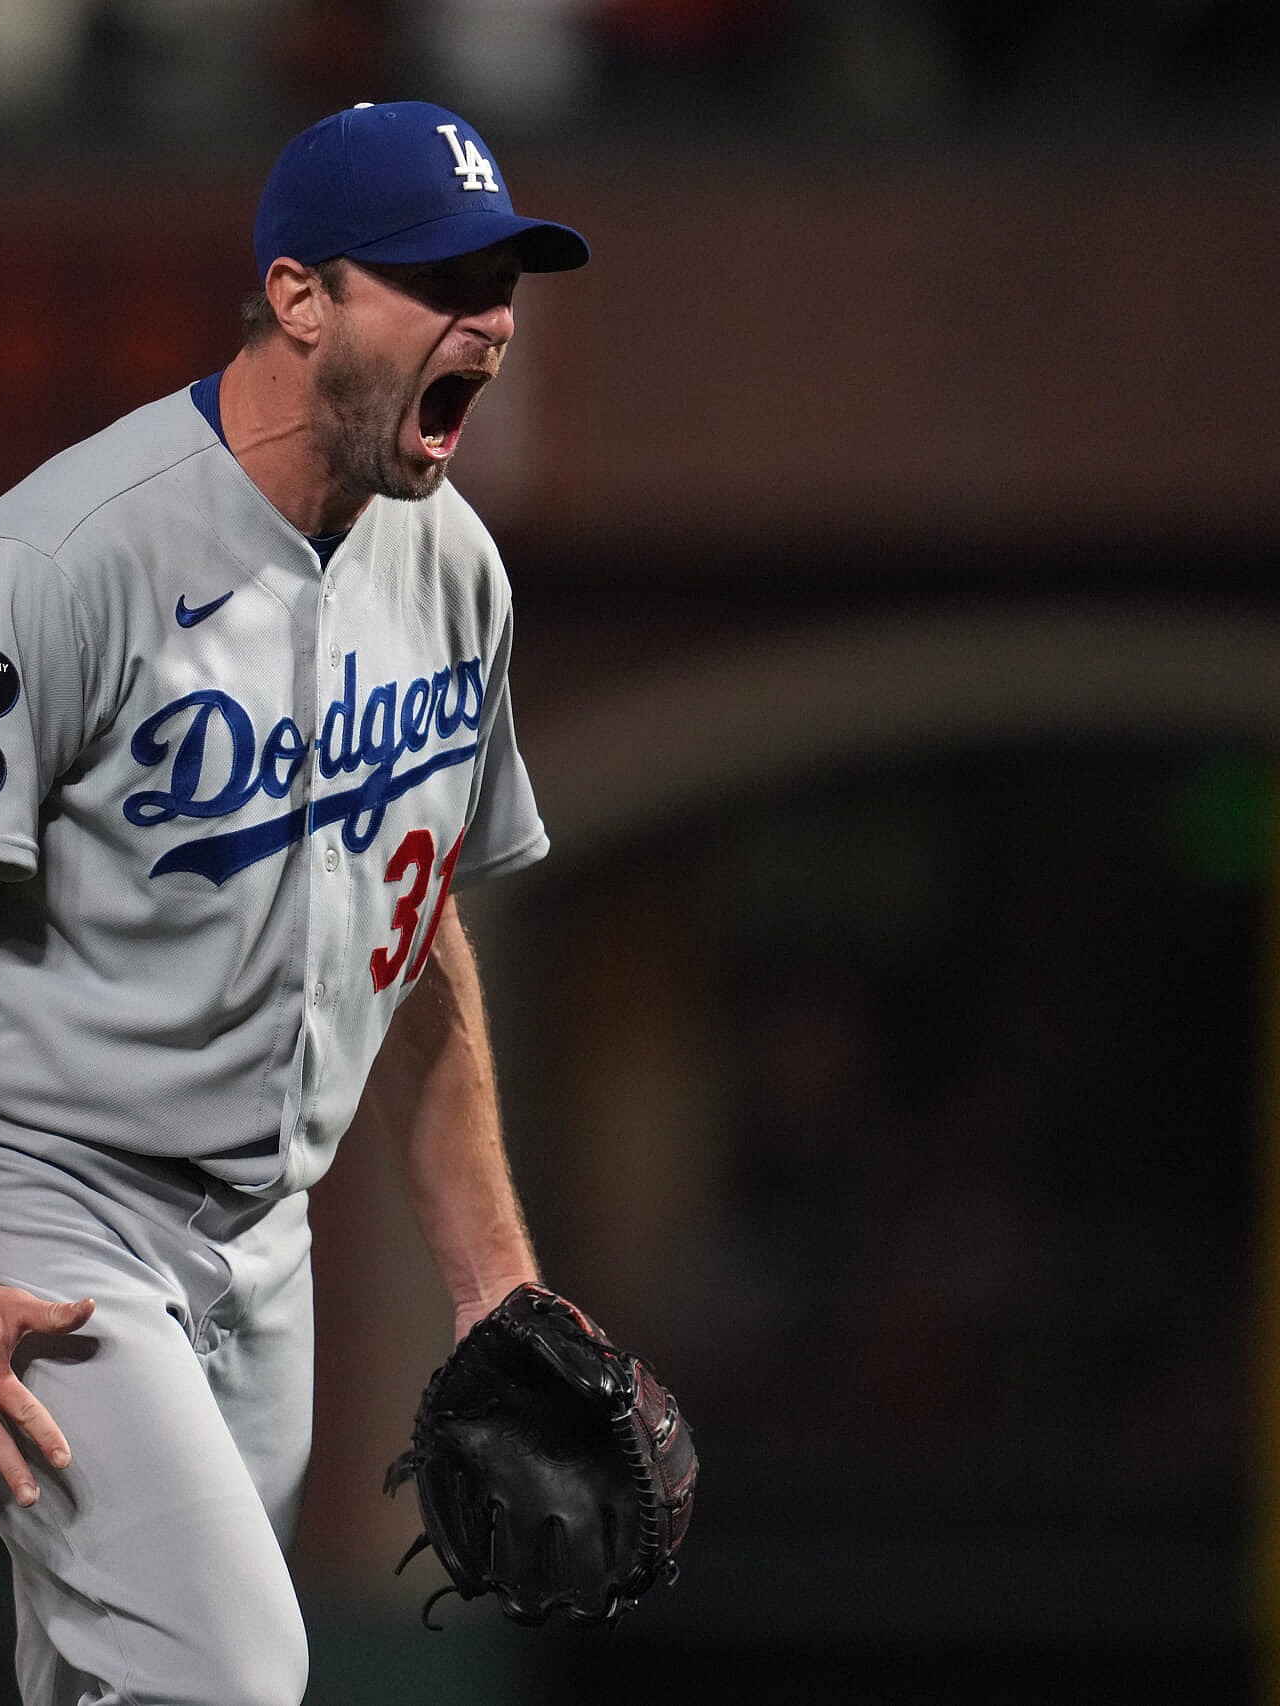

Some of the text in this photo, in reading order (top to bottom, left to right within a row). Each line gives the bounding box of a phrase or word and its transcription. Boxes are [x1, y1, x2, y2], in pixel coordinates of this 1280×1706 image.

[436, 124, 499, 192] LA
[122, 650, 484, 854] Dodgers
[370, 825, 466, 994] 31
